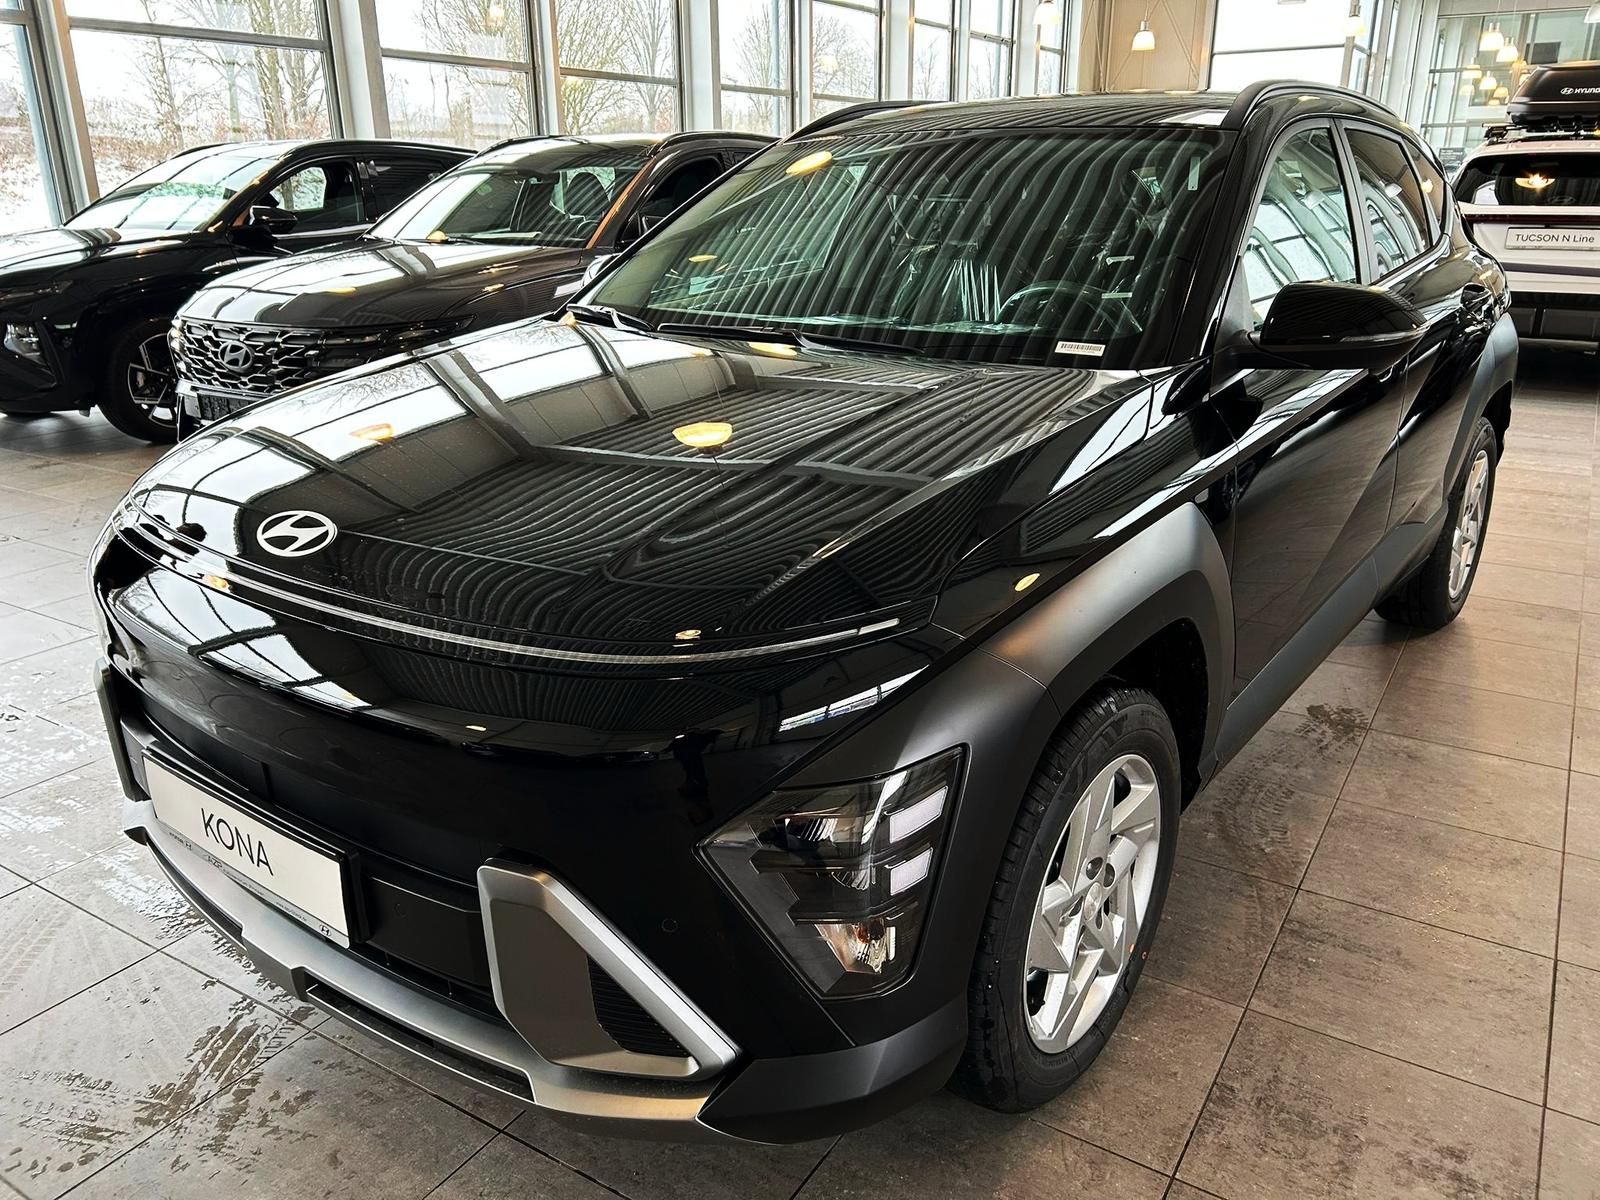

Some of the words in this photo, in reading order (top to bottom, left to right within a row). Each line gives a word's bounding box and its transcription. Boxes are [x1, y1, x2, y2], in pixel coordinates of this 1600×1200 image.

[1515, 233, 1560, 242] TUCSON
[1562, 234, 1571, 242] N
[1573, 234, 1595, 243] Line
[201, 808, 274, 876] KONA
